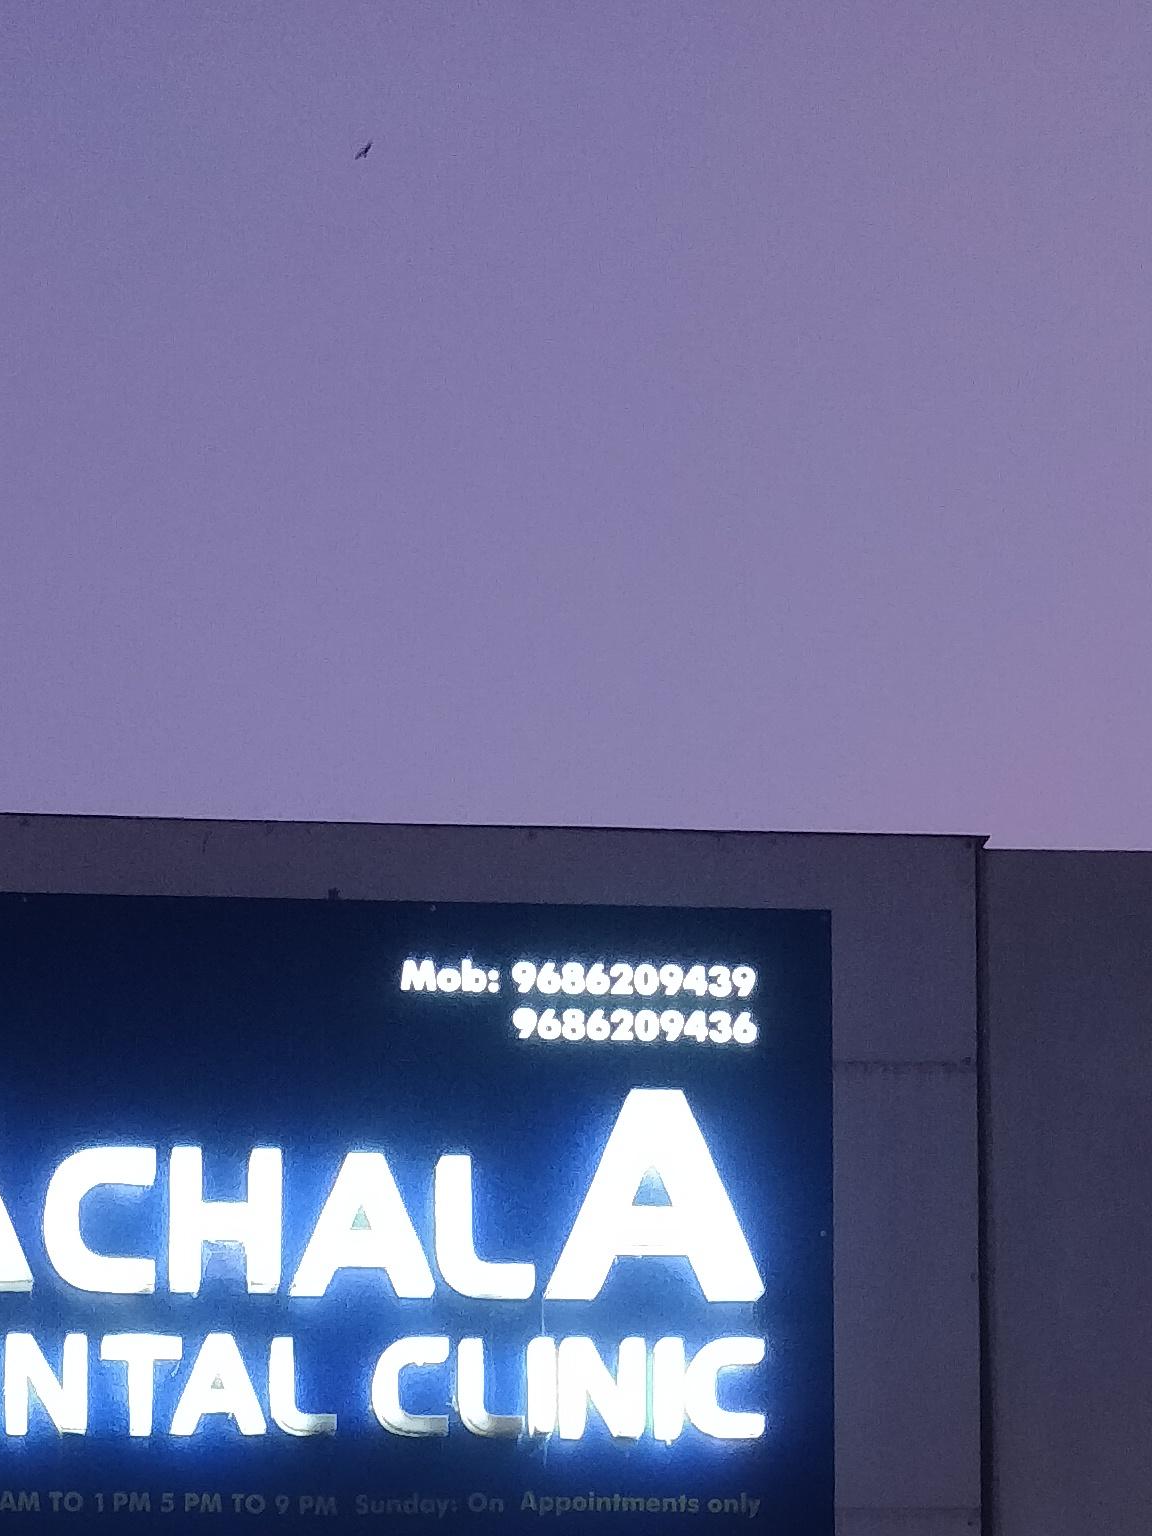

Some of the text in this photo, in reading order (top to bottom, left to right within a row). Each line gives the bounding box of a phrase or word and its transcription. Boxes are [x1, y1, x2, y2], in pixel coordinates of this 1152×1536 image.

[400, 957, 758, 998] Mob: 9686209439
[512, 1007, 759, 1044] 9686209436
[370, 1335, 766, 1442] CLINIC
[48, 1491, 83, 1513] TO
[94, 1492, 105, 1513] 1
[112, 1492, 151, 1513] PM
[160, 1492, 175, 1513] 5
[184, 1493, 223, 1514] PM
[232, 1493, 266, 1515] TO
[275, 1494, 290, 1515] 9
[299, 1495, 338, 1516] PM
[355, 1494, 457, 1519] Sunday:
[467, 1492, 504, 1514] On
[521, 1490, 699, 1517] Appointments
[708, 1492, 761, 1519] only
